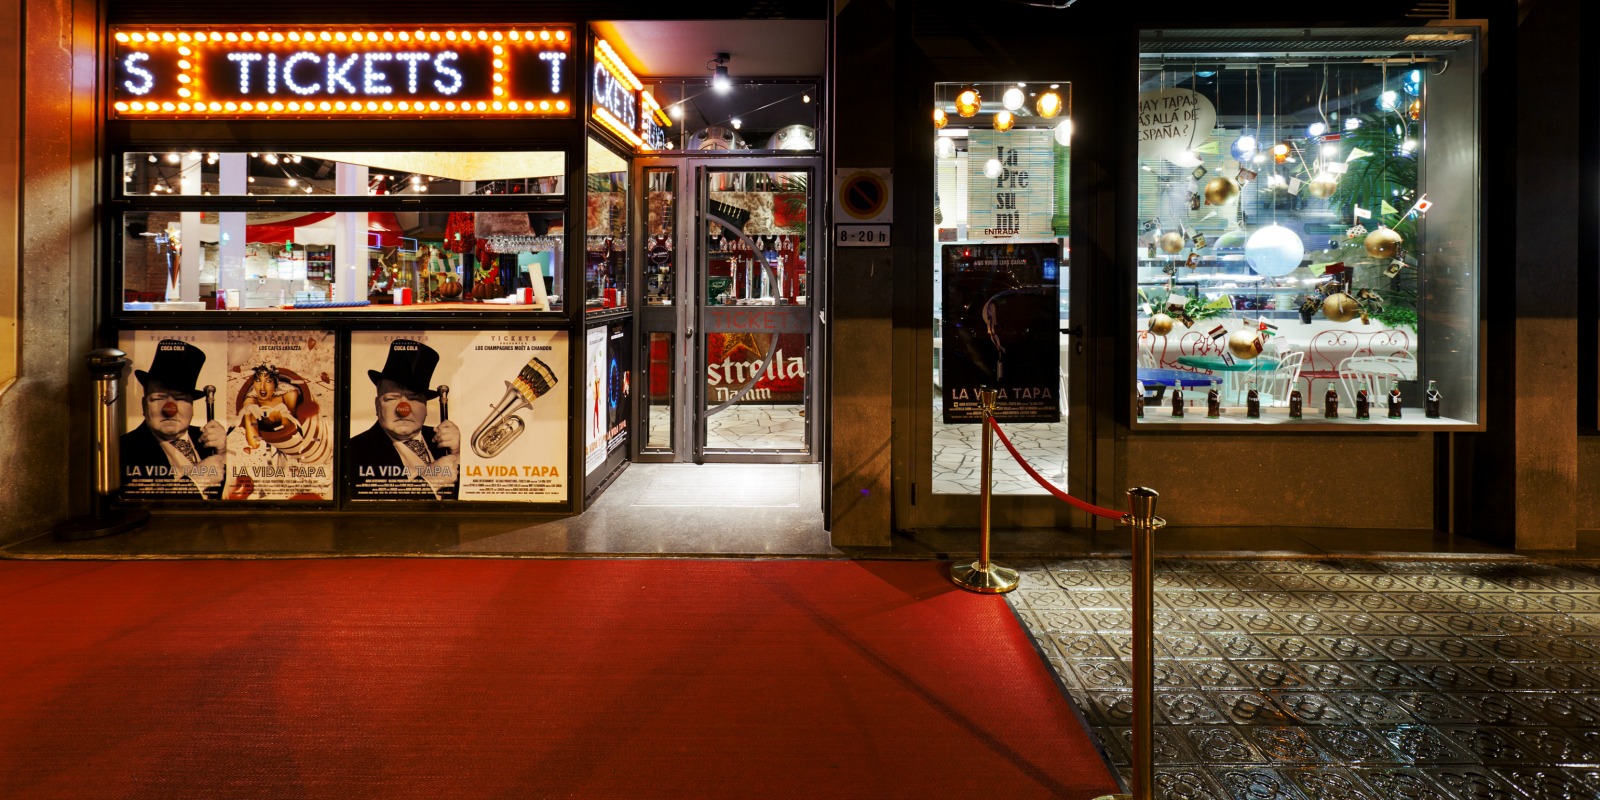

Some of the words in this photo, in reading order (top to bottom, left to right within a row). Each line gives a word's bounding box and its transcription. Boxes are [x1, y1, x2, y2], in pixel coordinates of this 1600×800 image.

[123, 51, 153, 96] S
[227, 51, 463, 96] TICKETS
[538, 51, 567, 95] T
[1162, 94, 1198, 110] TAPAS
[1184, 108, 1201, 121] DE
[996, 146, 1018, 167] La
[996, 168, 1029, 188] Pre
[879, 230, 886, 242] h
[711, 311, 808, 329] TICKETS
[952, 388, 969, 400] LA
[973, 388, 1008, 400] VA
[1012, 387, 1052, 399] TAPA
[126, 465, 142, 477] LA
[145, 465, 178, 477] VIDA
[182, 465, 219, 477] TAPA
[232, 466, 249, 478] LA
[252, 466, 286, 478] VIDA
[289, 466, 327, 478] TAPA
[359, 465, 375, 477] LA
[378, 465, 412, 477] VIDA
[416, 465, 452, 477] TAPA
[466, 465, 482, 477] LA
[486, 465, 518, 477] VIDA
[523, 465, 559, 477] TAPA
